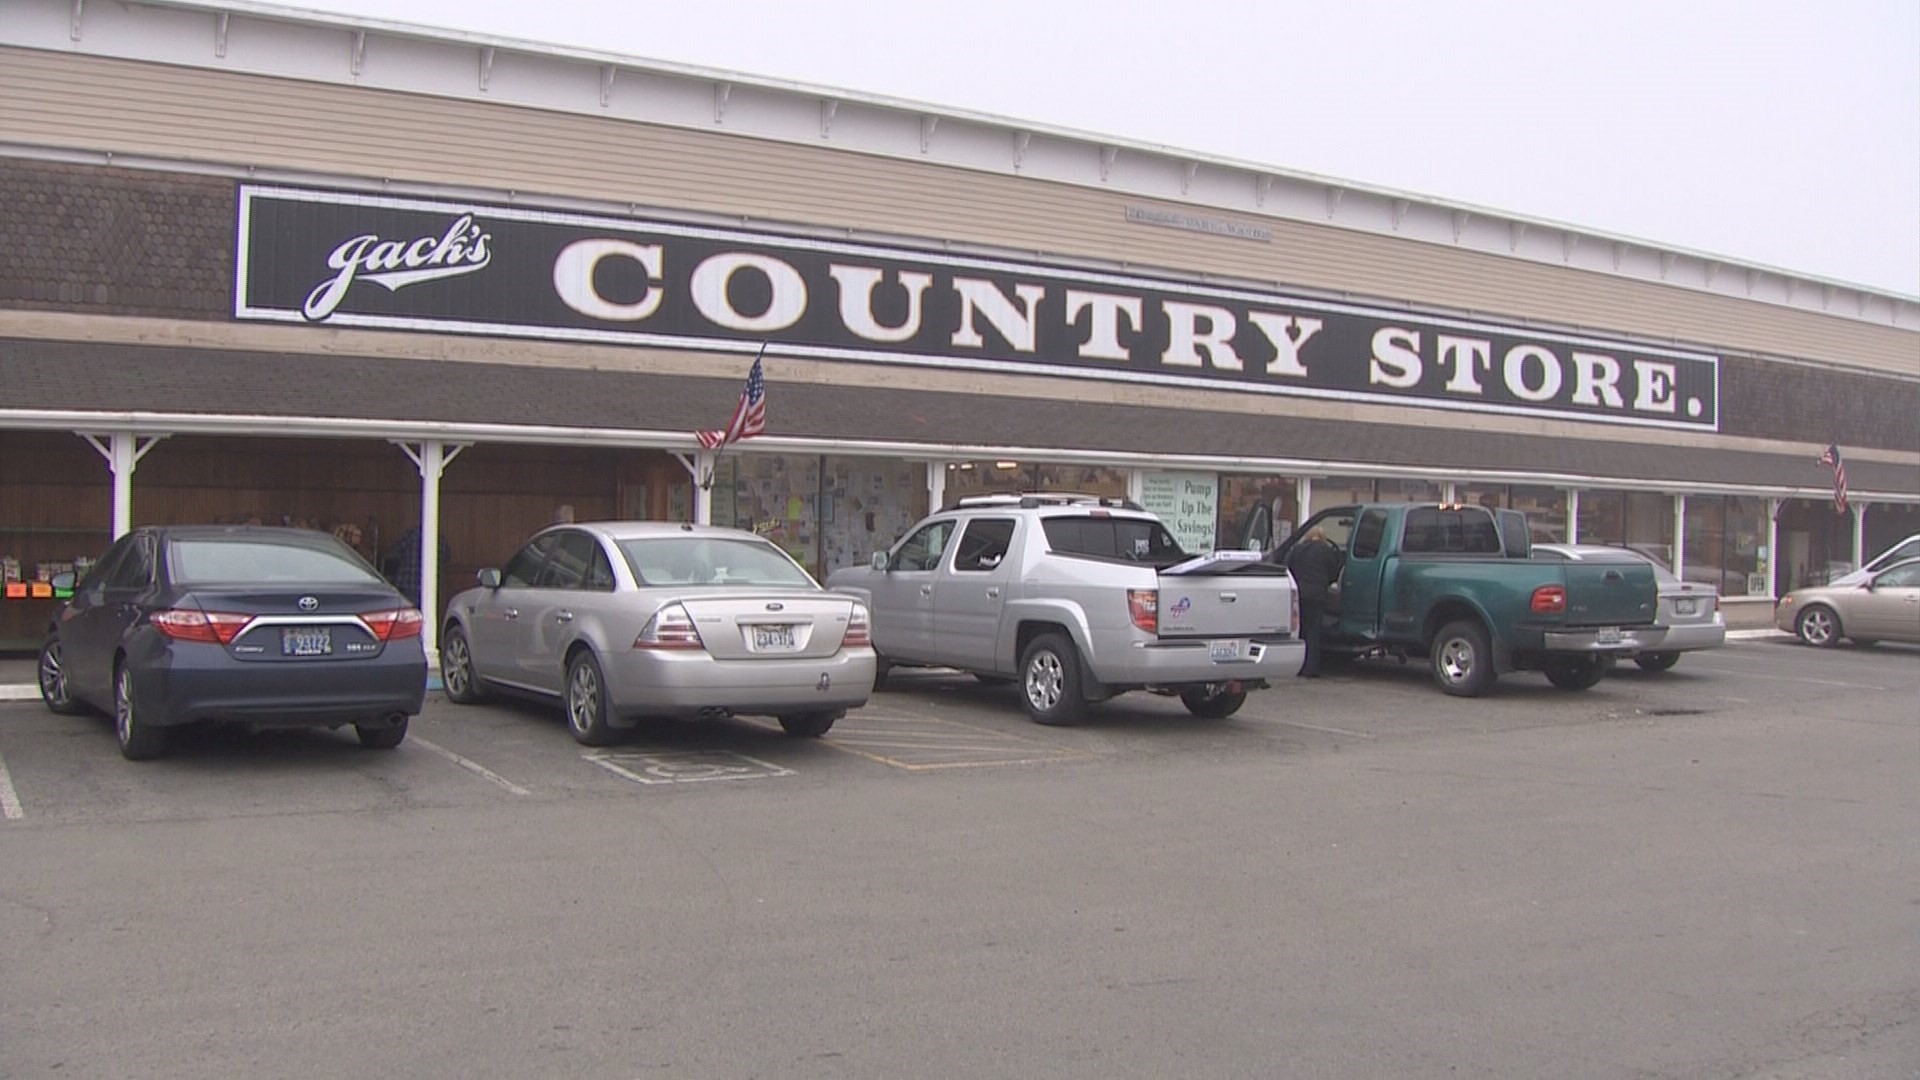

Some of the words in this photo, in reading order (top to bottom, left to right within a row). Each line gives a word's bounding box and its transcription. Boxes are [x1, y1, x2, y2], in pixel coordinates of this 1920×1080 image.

[553, 237, 1323, 377] COUNTRY
[1369, 326, 1702, 417] STORE.
[1184, 479, 1212, 499] Pump
[1181, 499, 1194, 517] Up
[1196, 500, 1212, 514] The
[1177, 519, 1215, 538] Savings!
